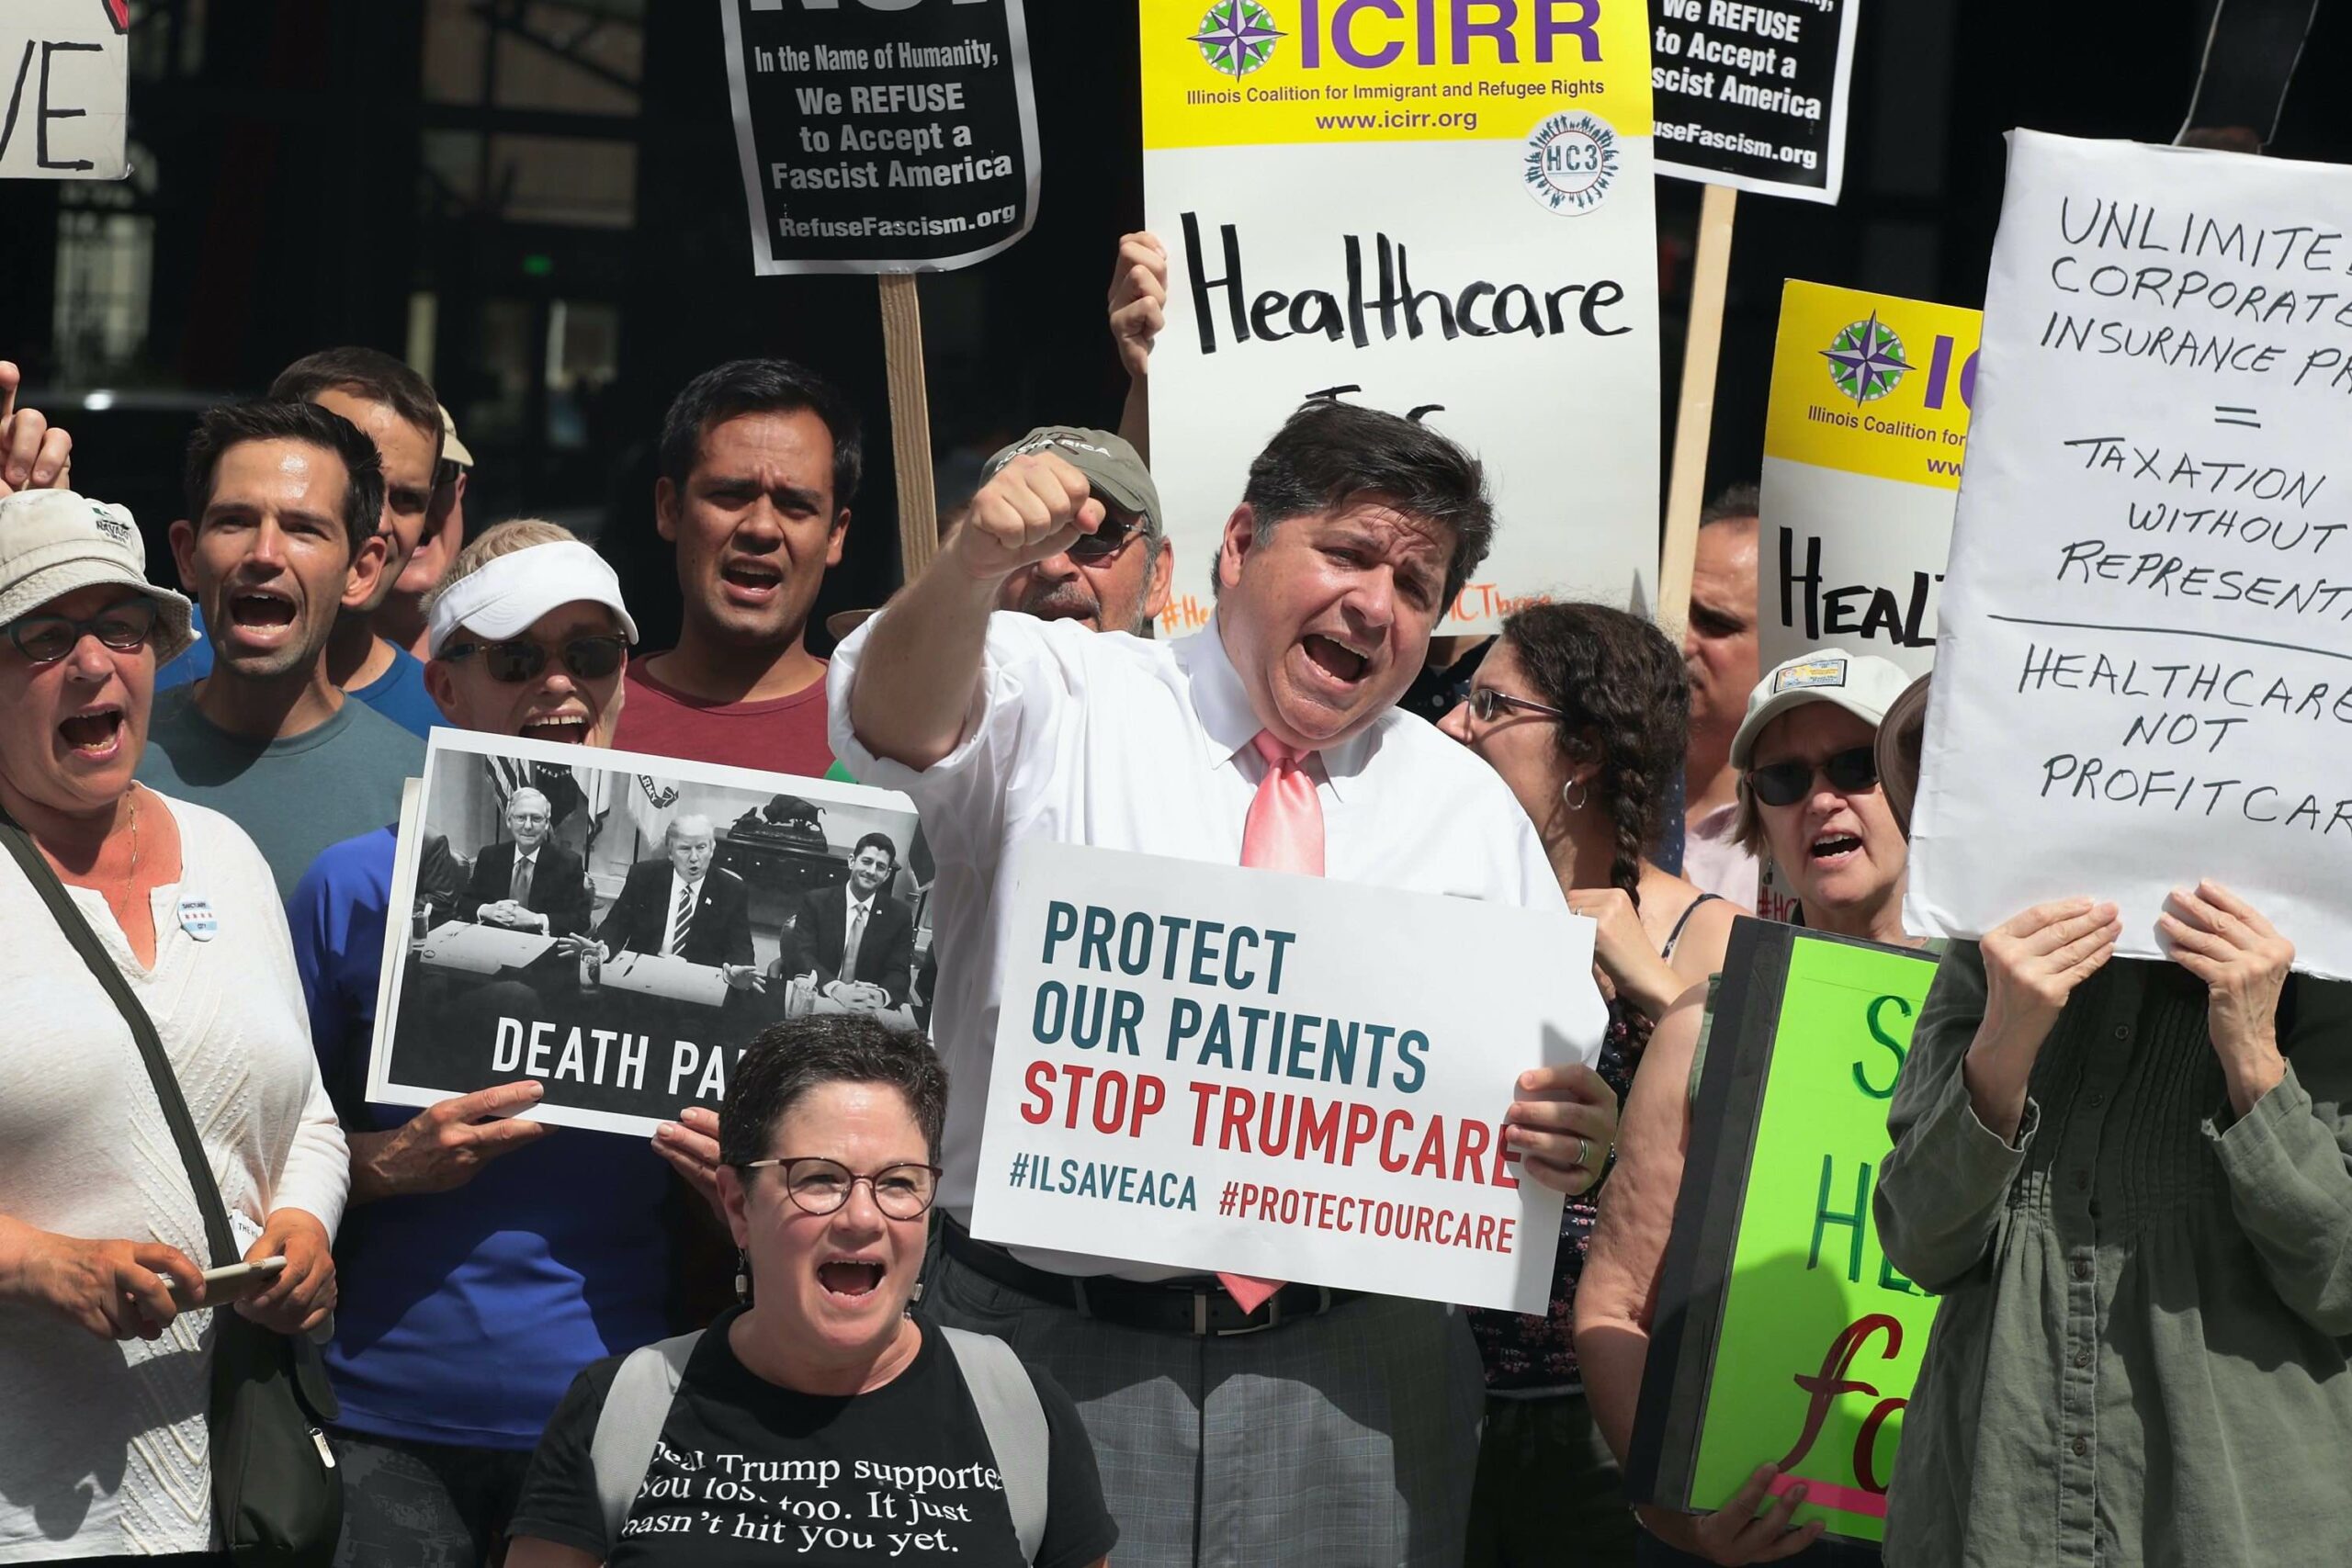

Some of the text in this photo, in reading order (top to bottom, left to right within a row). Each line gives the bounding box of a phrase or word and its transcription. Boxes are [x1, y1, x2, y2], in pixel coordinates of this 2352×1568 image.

[1300, 0, 1603, 70] ICIRR
[1662, 0, 1801, 42] We REFUSE
[754, 39, 999, 73] In the Name of Humanity,
[1656, 26, 1797, 78] to Accept a
[796, 83, 966, 115] We REFUSE
[1187, 79, 1604, 105] Illinois Coalition for Immigrant and Refugee Rights
[1719, 74, 1821, 120] America
[799, 123, 972, 155] to Accept a
[1316, 109, 1477, 130] www.icirr.org
[771, 153, 1012, 189] Fascist America
[1546, 144, 1598, 172] HC3
[779, 204, 1016, 237] RefuseFascism.org
[2061, 196, 2352, 276] UNLIMITE
[1180, 211, 1633, 355] Healthcare
[2040, 310, 2287, 373] INSURANCE
[1060, 440, 1111, 457] RICA
[1808, 405, 1966, 446] Illinois Coalition for
[2064, 436, 2326, 509] TAXATION
[2129, 501, 2348, 554] WITHOUT
[1779, 525, 1946, 648] HEAL
[2057, 539, 2352, 622] REPRESENT
[2122, 712, 2249, 753] NOT
[1041, 900, 1296, 995] PROTECT
[492, 1016, 747, 1101] DEATH PA
[1032, 979, 1430, 1094] OUR PATIENTS
[1020, 1059, 1524, 1190] STOP TRUMPCARE
[1009, 1151, 1517, 1255] #ILSAVEACA #PROTECTOURCARE
[716, 1454, 841, 1489] Trump
[638, 1474, 691, 1498] you
[866, 1491, 898, 1518] It
[906, 1493, 972, 1526] just
[730, 1512, 786, 1543] hit
[797, 1525, 876, 1552] you
[887, 1529, 959, 1557] yet.
